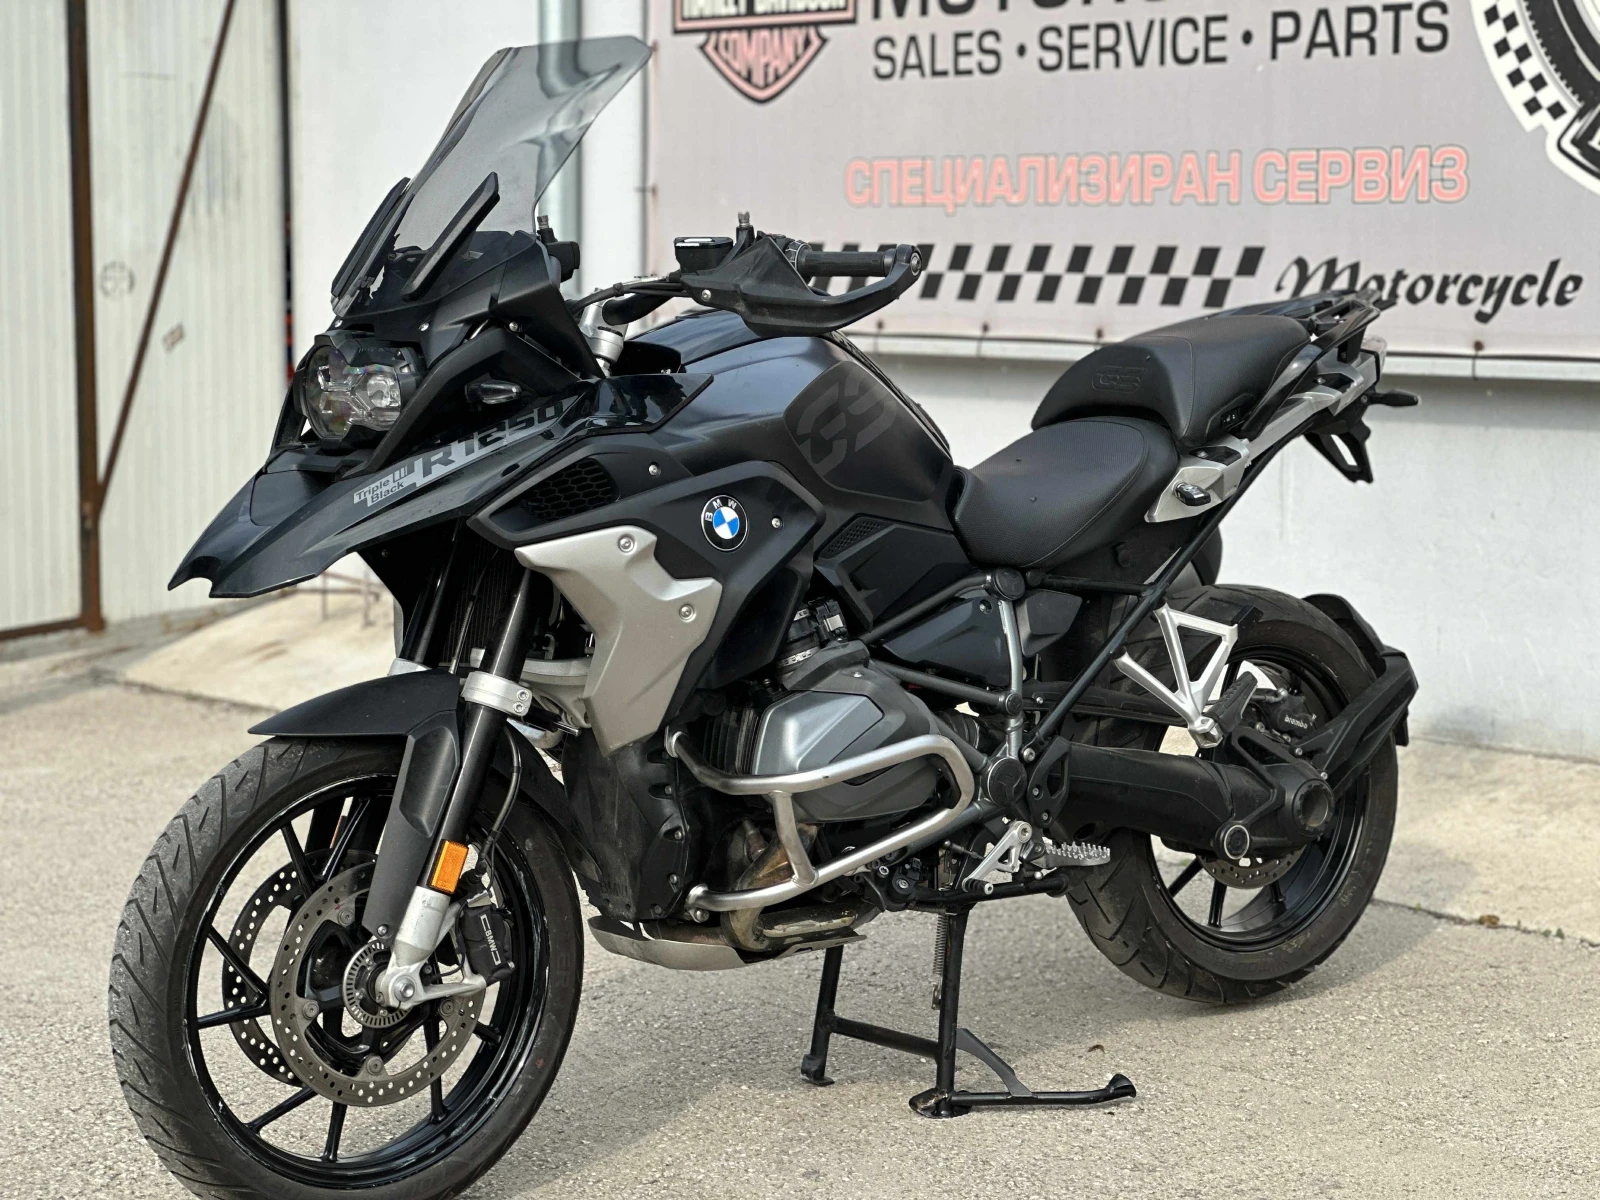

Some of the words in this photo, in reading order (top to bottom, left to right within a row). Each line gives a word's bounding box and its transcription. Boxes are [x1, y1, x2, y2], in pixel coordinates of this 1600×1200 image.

[872, 29, 1003, 80] SALES
[1037, 13, 1229, 73] SERVICE
[1270, 0, 1450, 61] PARTS
[844, 151, 1242, 217] СПЕЦИАЛИЗИРАН
[1251, 144, 1469, 205] СЕРВИЗ
[1274, 255, 1584, 325] Motorcycle
[355, 479, 390, 501] Triple
[370, 481, 405, 503] Black
[704, 498, 738, 522] BMW
[1284, 714, 1308, 729] brembo
[485, 929, 498, 952] BMW
